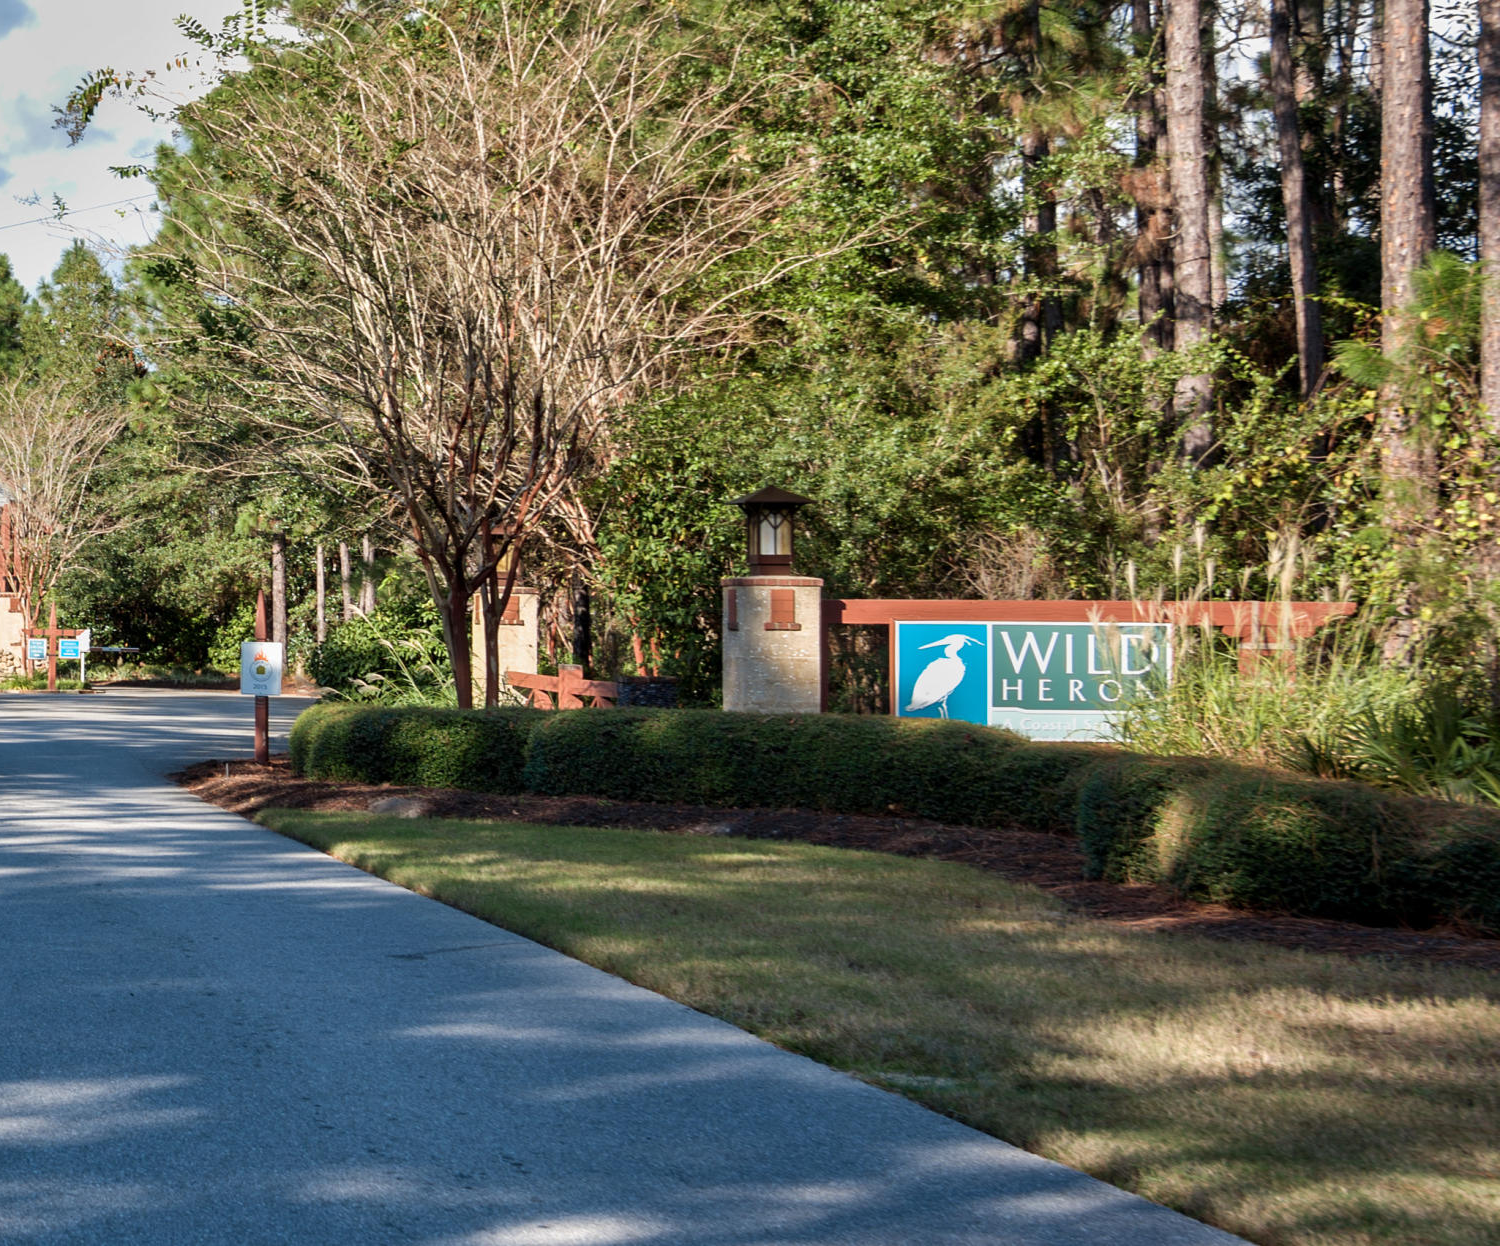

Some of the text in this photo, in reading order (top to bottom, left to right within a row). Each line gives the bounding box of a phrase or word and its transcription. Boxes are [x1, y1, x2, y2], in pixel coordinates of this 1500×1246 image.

[1000, 631, 1159, 675] WILD
[1002, 718, 1013, 730] A
[1020, 717, 1077, 731] Coastal
